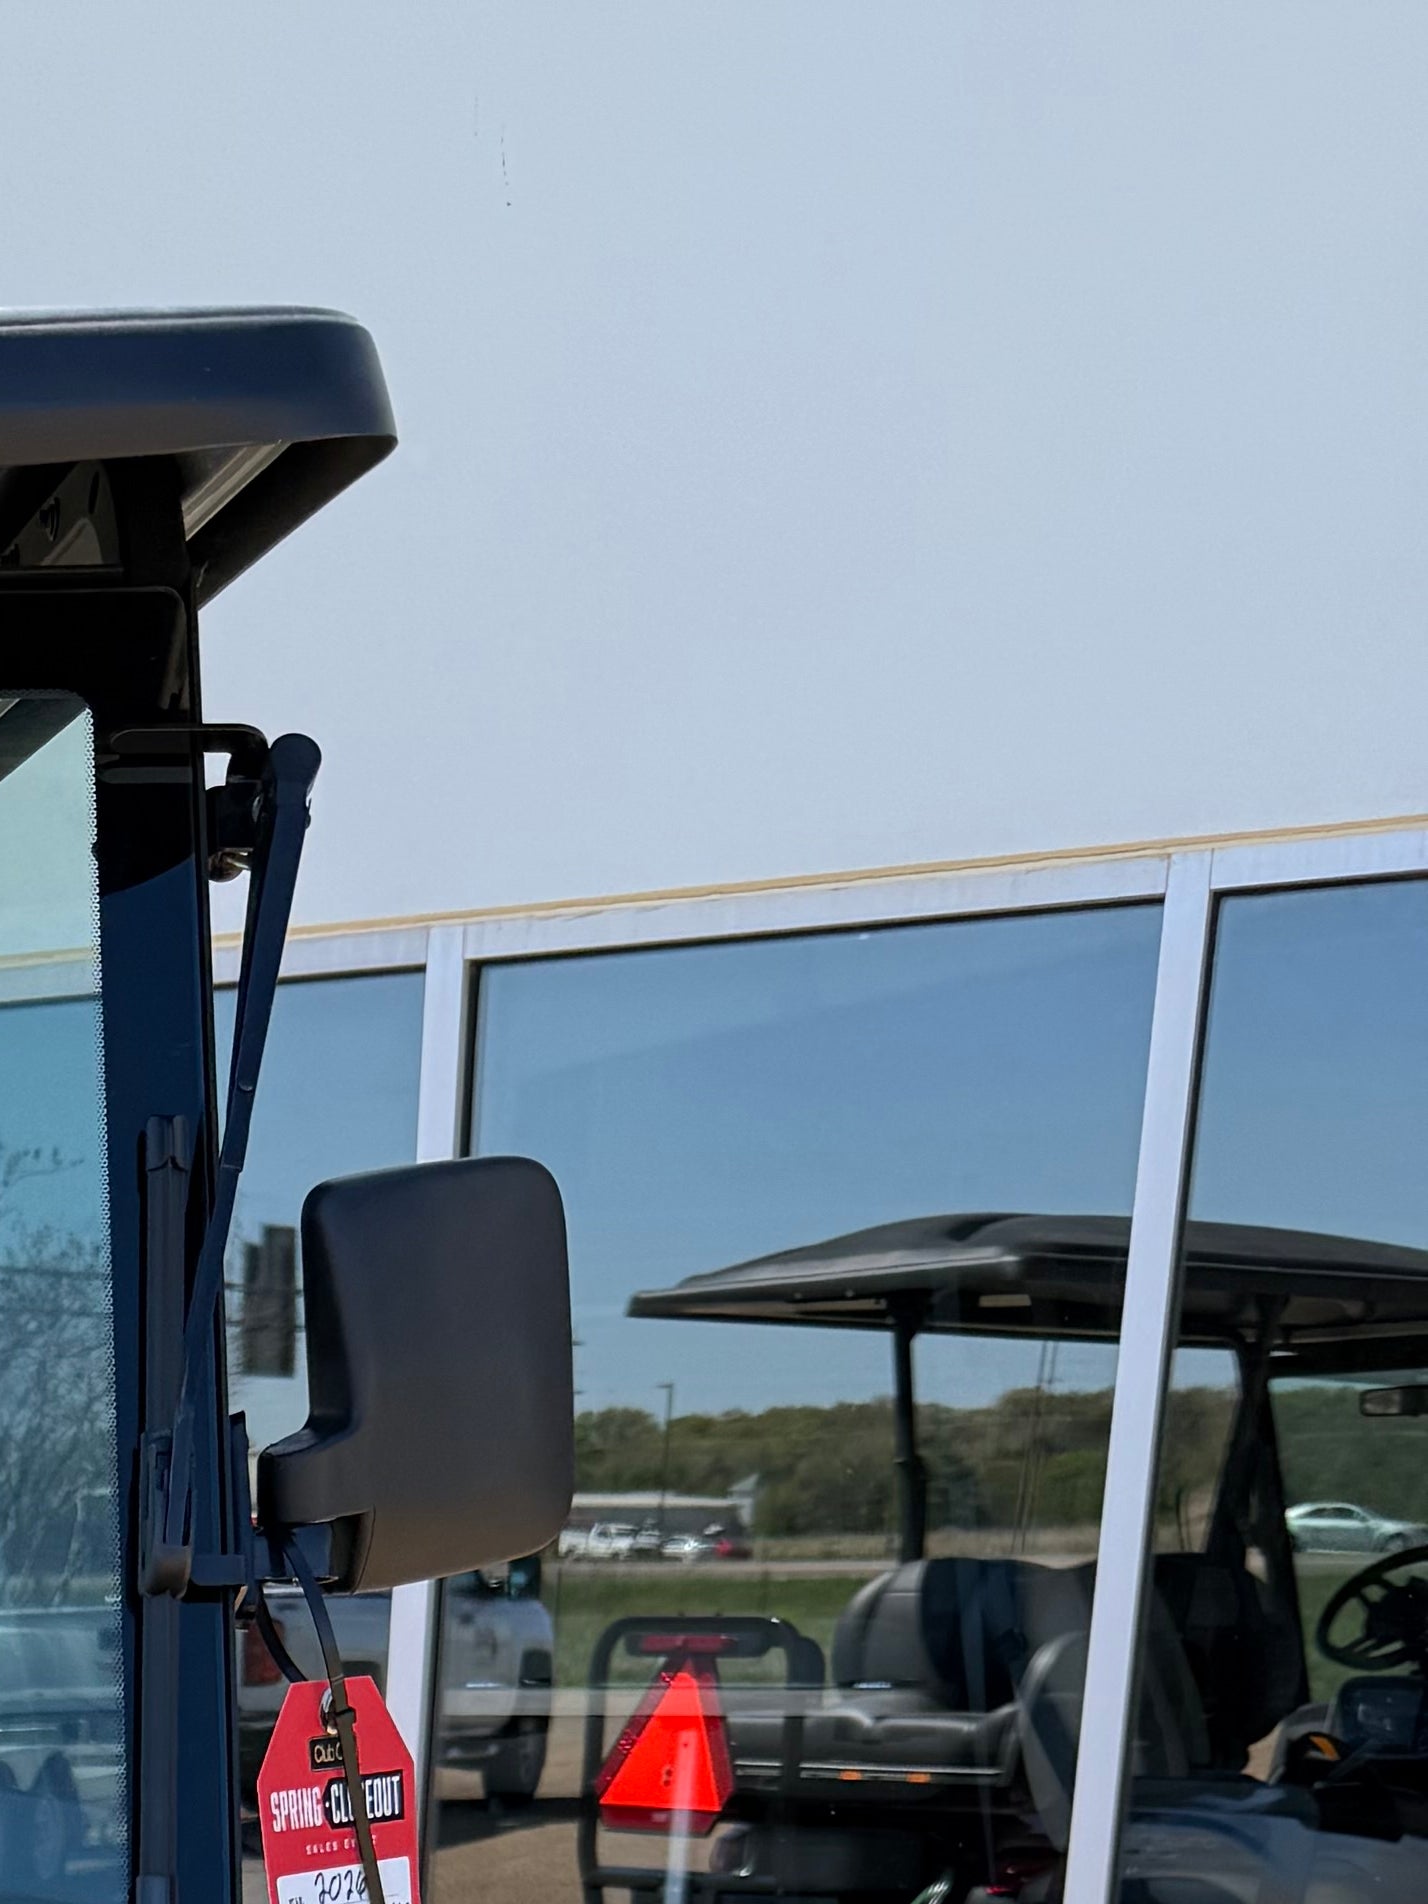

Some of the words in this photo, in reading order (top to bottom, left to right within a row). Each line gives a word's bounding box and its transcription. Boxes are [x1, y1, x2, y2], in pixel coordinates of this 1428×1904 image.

[270, 1786, 323, 1833] SPRING
[330, 1775, 401, 1824] CLEOUT
[305, 1841, 338, 1856] SALES
